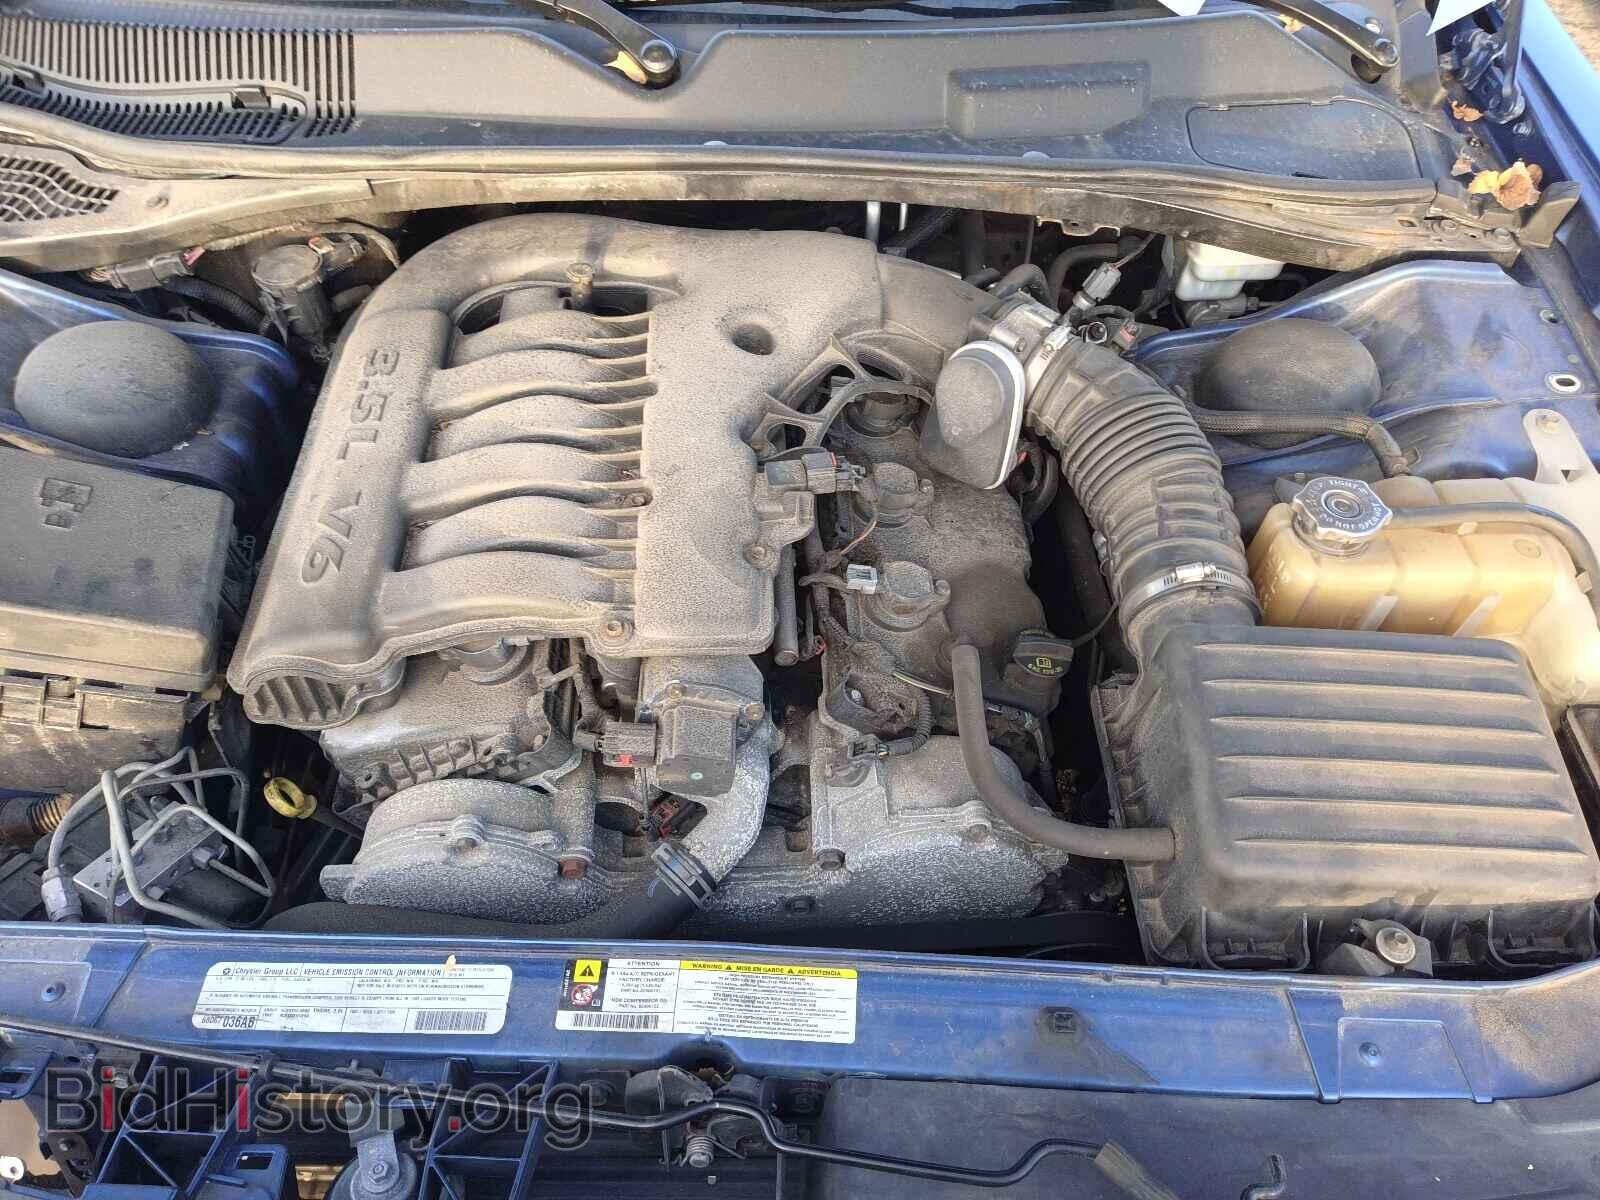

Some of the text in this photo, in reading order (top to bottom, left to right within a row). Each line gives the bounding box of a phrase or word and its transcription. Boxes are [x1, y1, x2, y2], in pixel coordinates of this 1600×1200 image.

[301, 348, 400, 583] 3.5L V6
[235, 967, 298, 977] Chrysler Group LLC
[304, 968, 330, 976] VEHICLE
[331, 968, 363, 976] EMISSION
[365, 968, 394, 977] CONTROL
[396, 968, 442, 977] INFORMATION
[797, 969, 841, 977] ADVERTENCIA
